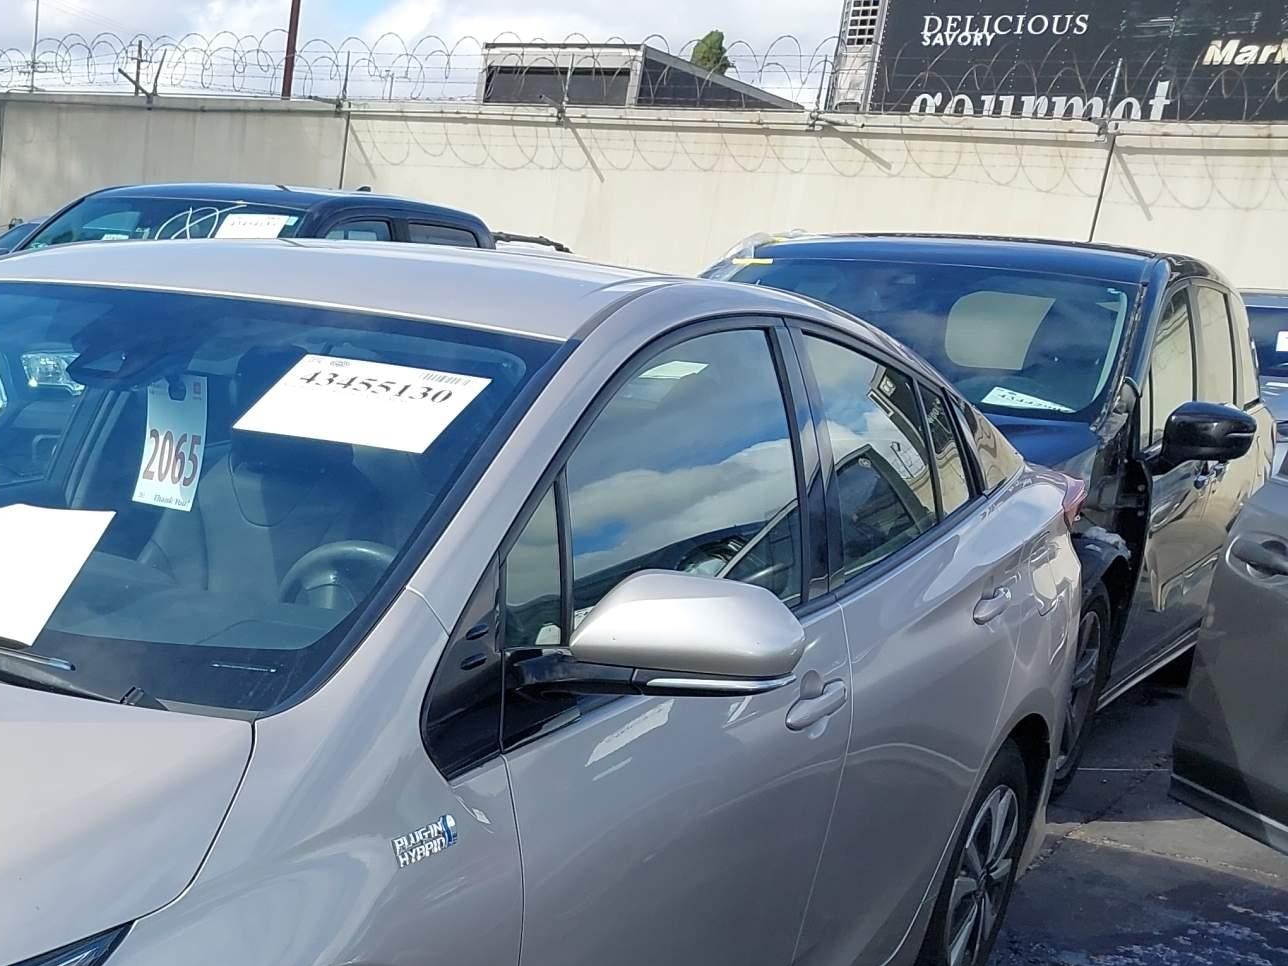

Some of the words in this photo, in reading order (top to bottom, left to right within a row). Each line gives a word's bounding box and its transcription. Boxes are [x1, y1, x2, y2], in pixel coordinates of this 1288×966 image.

[920, 14, 1089, 36] DELICIOUS
[921, 32, 996, 47] SAVORY
[299, 370, 453, 404] 43455130
[142, 428, 202, 487] 2065
